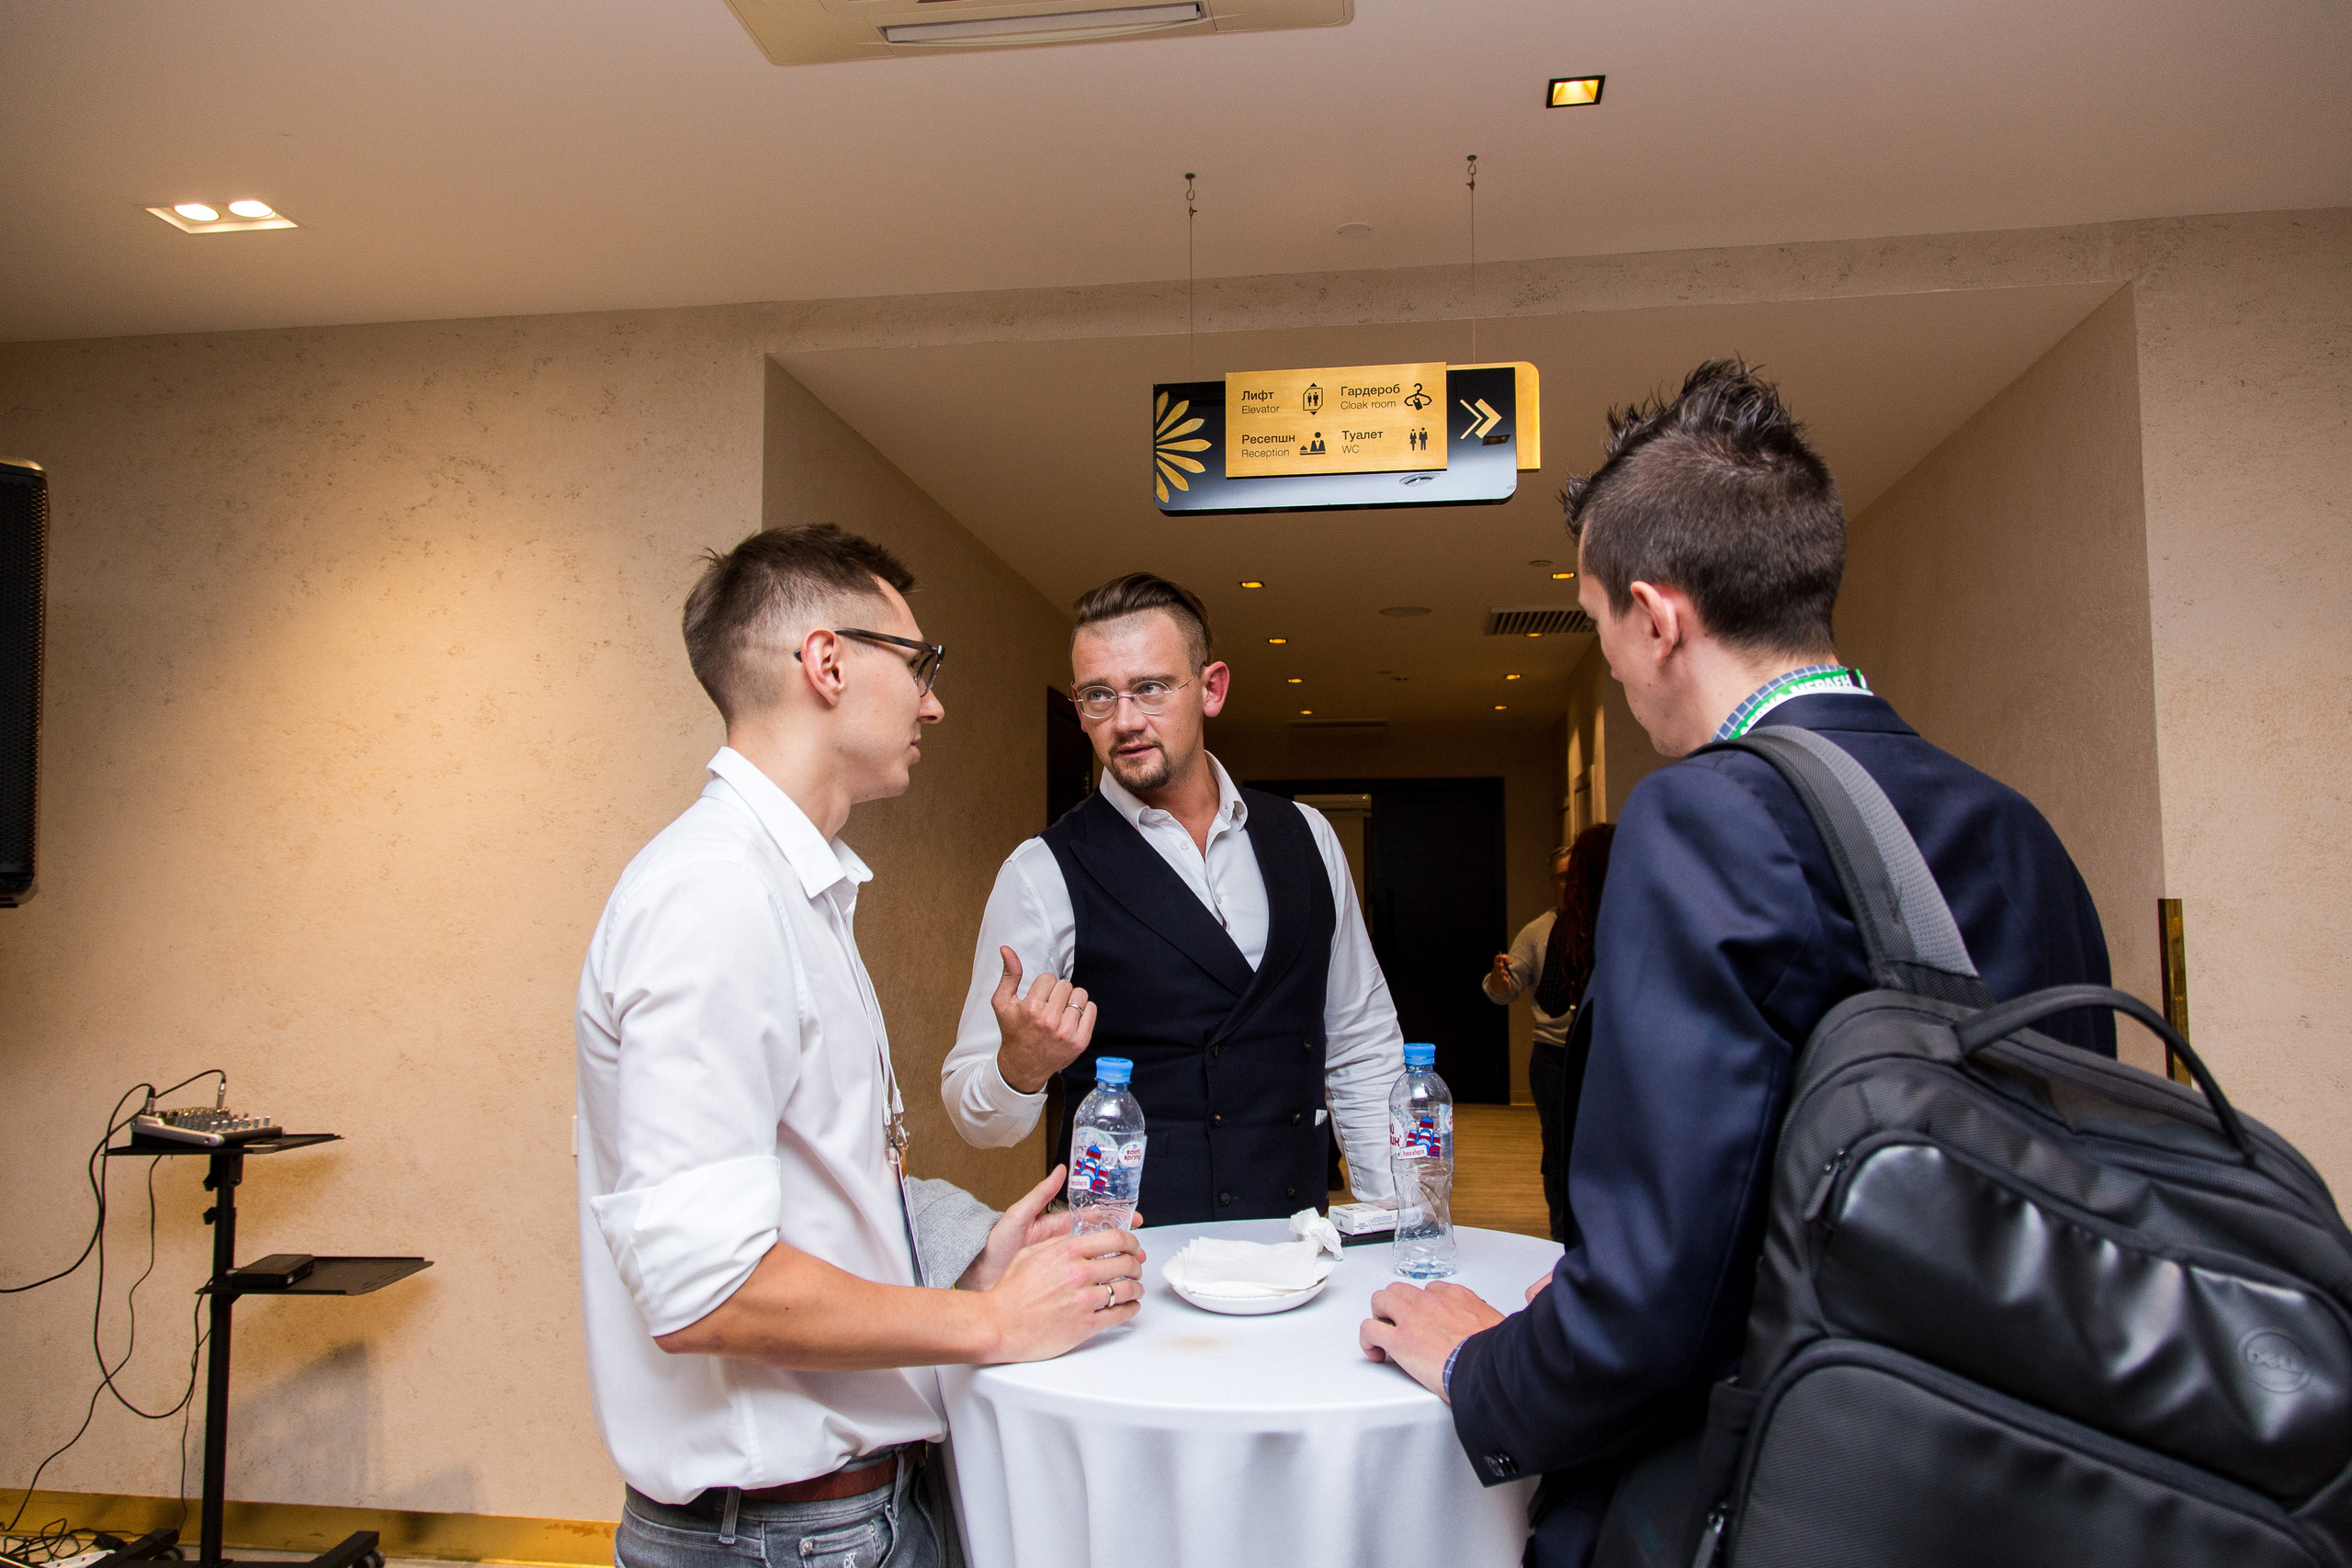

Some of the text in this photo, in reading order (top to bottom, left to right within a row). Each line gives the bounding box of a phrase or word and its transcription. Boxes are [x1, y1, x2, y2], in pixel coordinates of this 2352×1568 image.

[1241, 389, 1274, 401] Лифт
[1340, 384, 1401, 398] Гардероб
[1241, 404, 1280, 414] Elevator
[1340, 400, 1396, 411] Cloak room
[1241, 434, 1296, 445] Ресепшн
[1341, 430, 1384, 442] Туалет
[1241, 448, 1290, 459] Reception
[1341, 445, 1361, 454] WC
